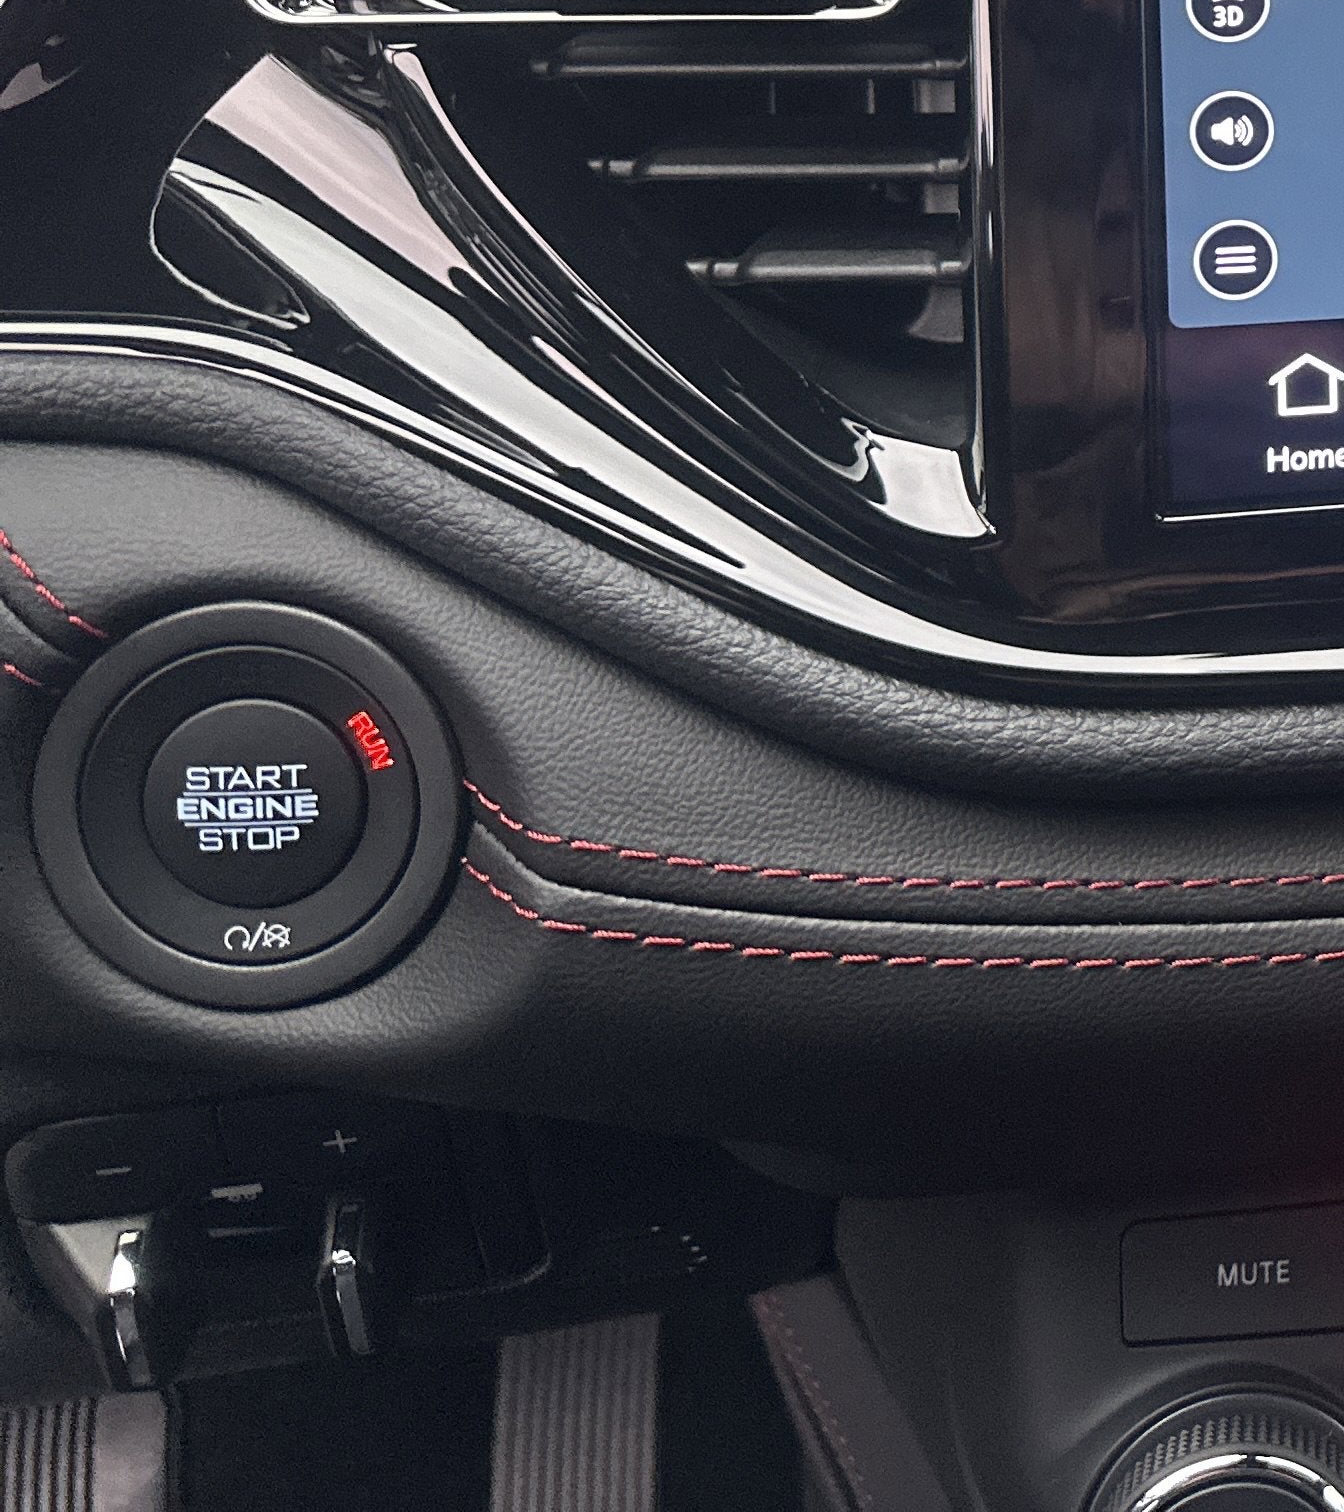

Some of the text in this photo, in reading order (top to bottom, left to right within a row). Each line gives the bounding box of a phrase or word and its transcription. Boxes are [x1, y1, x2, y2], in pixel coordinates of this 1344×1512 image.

[1213, 6, 1244, 28] 3D
[347, 711, 394, 770] RUN
[185, 764, 307, 790] START
[176, 794, 319, 821] ENGINE
[199, 826, 300, 851] STOP
[1217, 1258, 1291, 1287] MUTE
